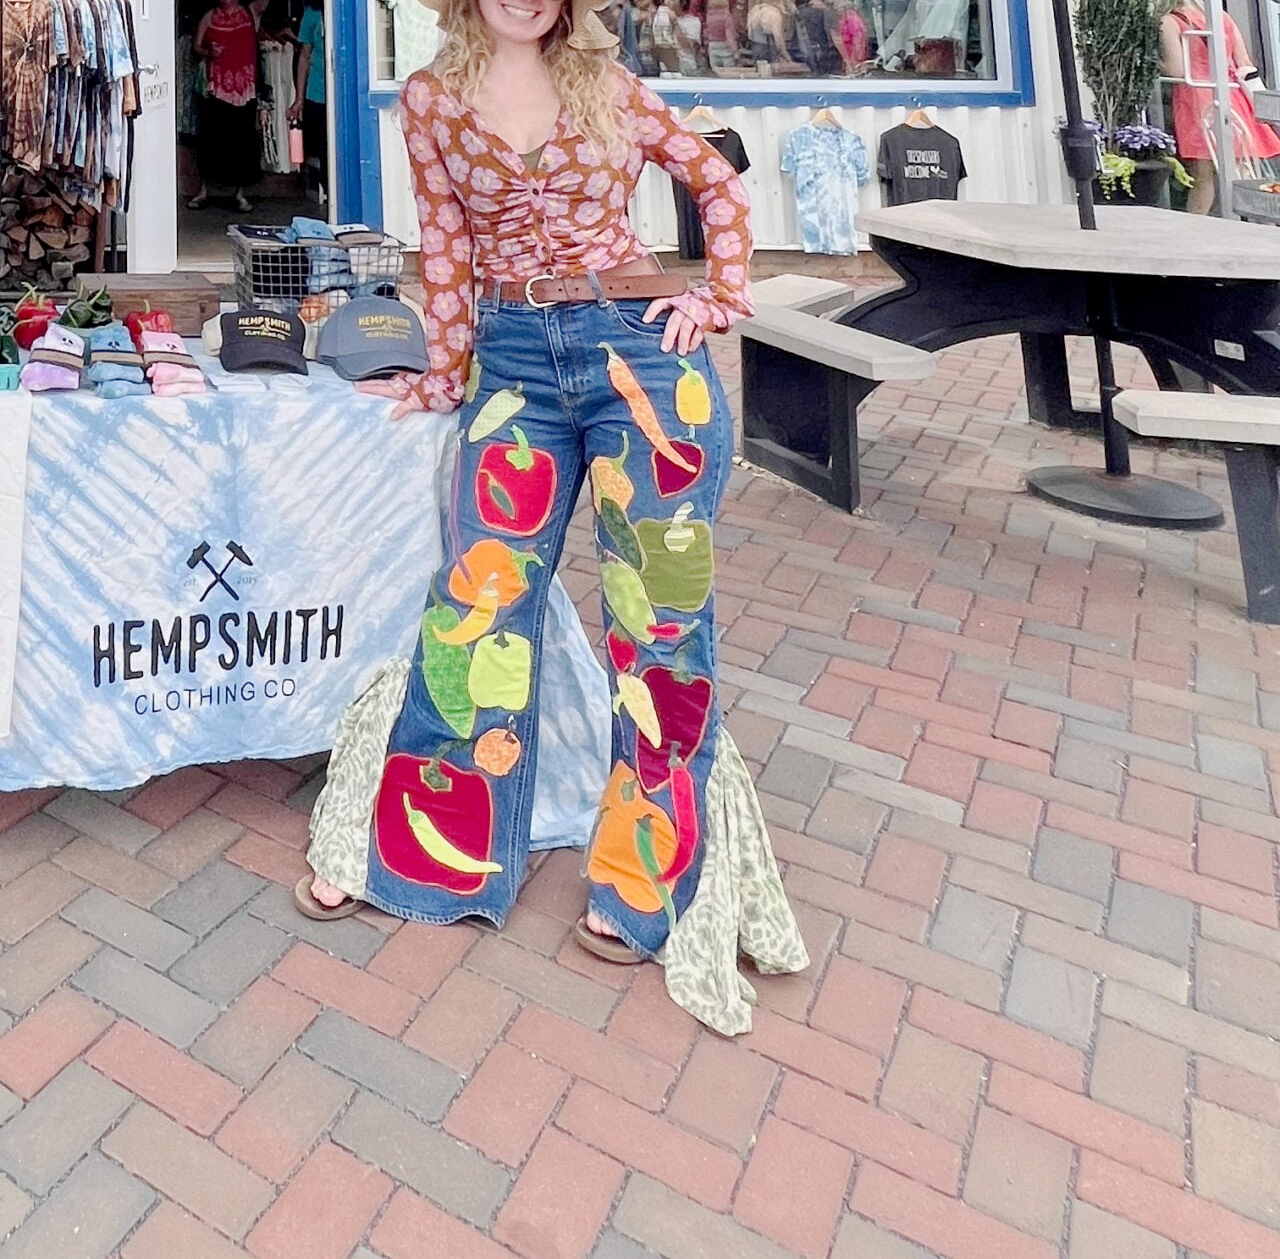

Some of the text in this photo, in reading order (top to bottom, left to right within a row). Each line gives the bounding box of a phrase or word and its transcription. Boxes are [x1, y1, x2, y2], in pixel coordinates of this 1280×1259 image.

[238, 316, 291, 331] HEMPSMITH
[93, 604, 344, 688] HEMPSMITH
[134, 681, 255, 715] CLOTHING
